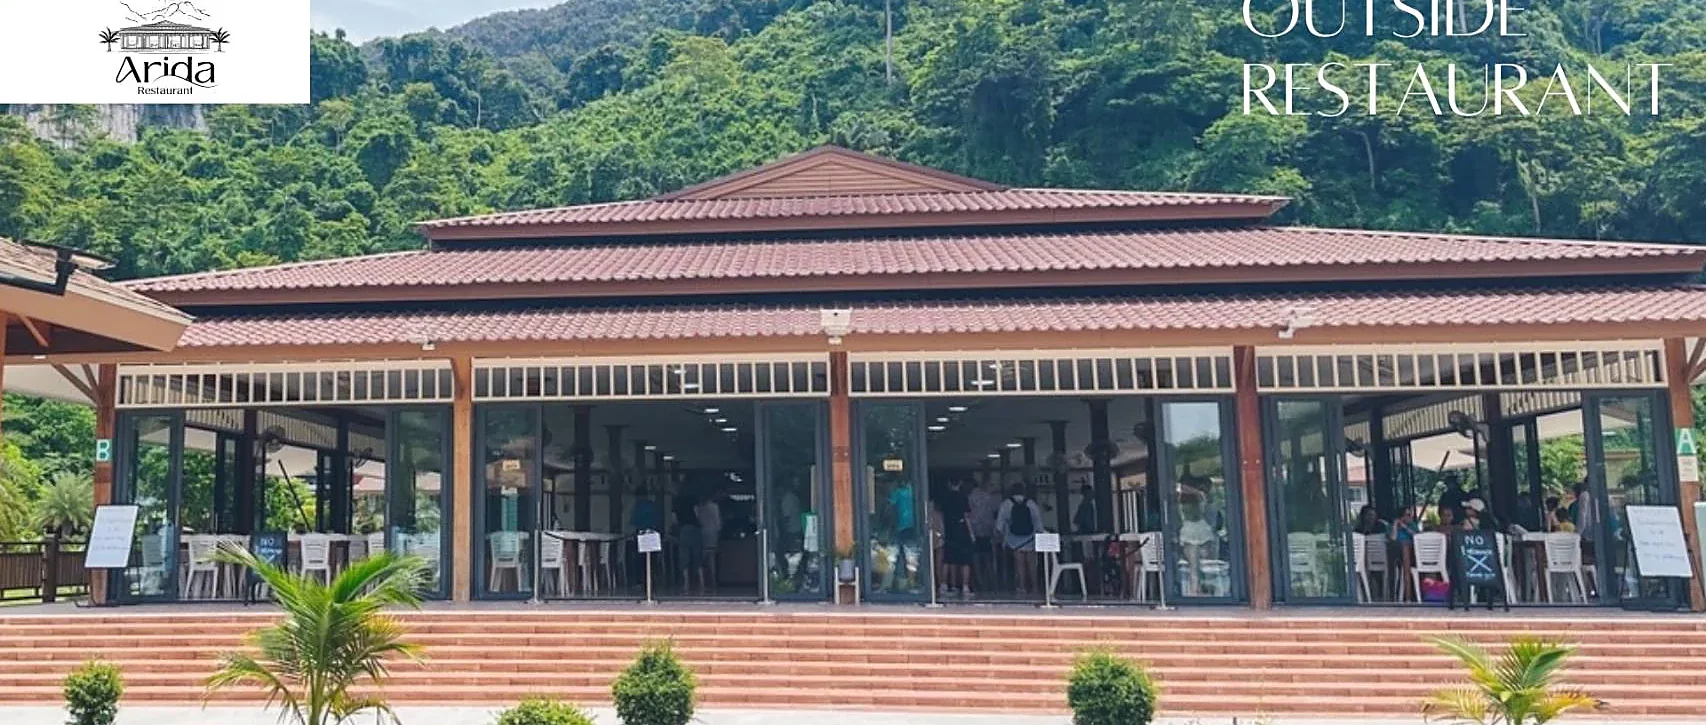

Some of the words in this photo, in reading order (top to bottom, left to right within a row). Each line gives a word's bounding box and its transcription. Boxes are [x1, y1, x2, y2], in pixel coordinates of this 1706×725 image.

[96, 440, 111, 460] B
[1677, 428, 1696, 454] A
[1464, 535, 1484, 545] NO
